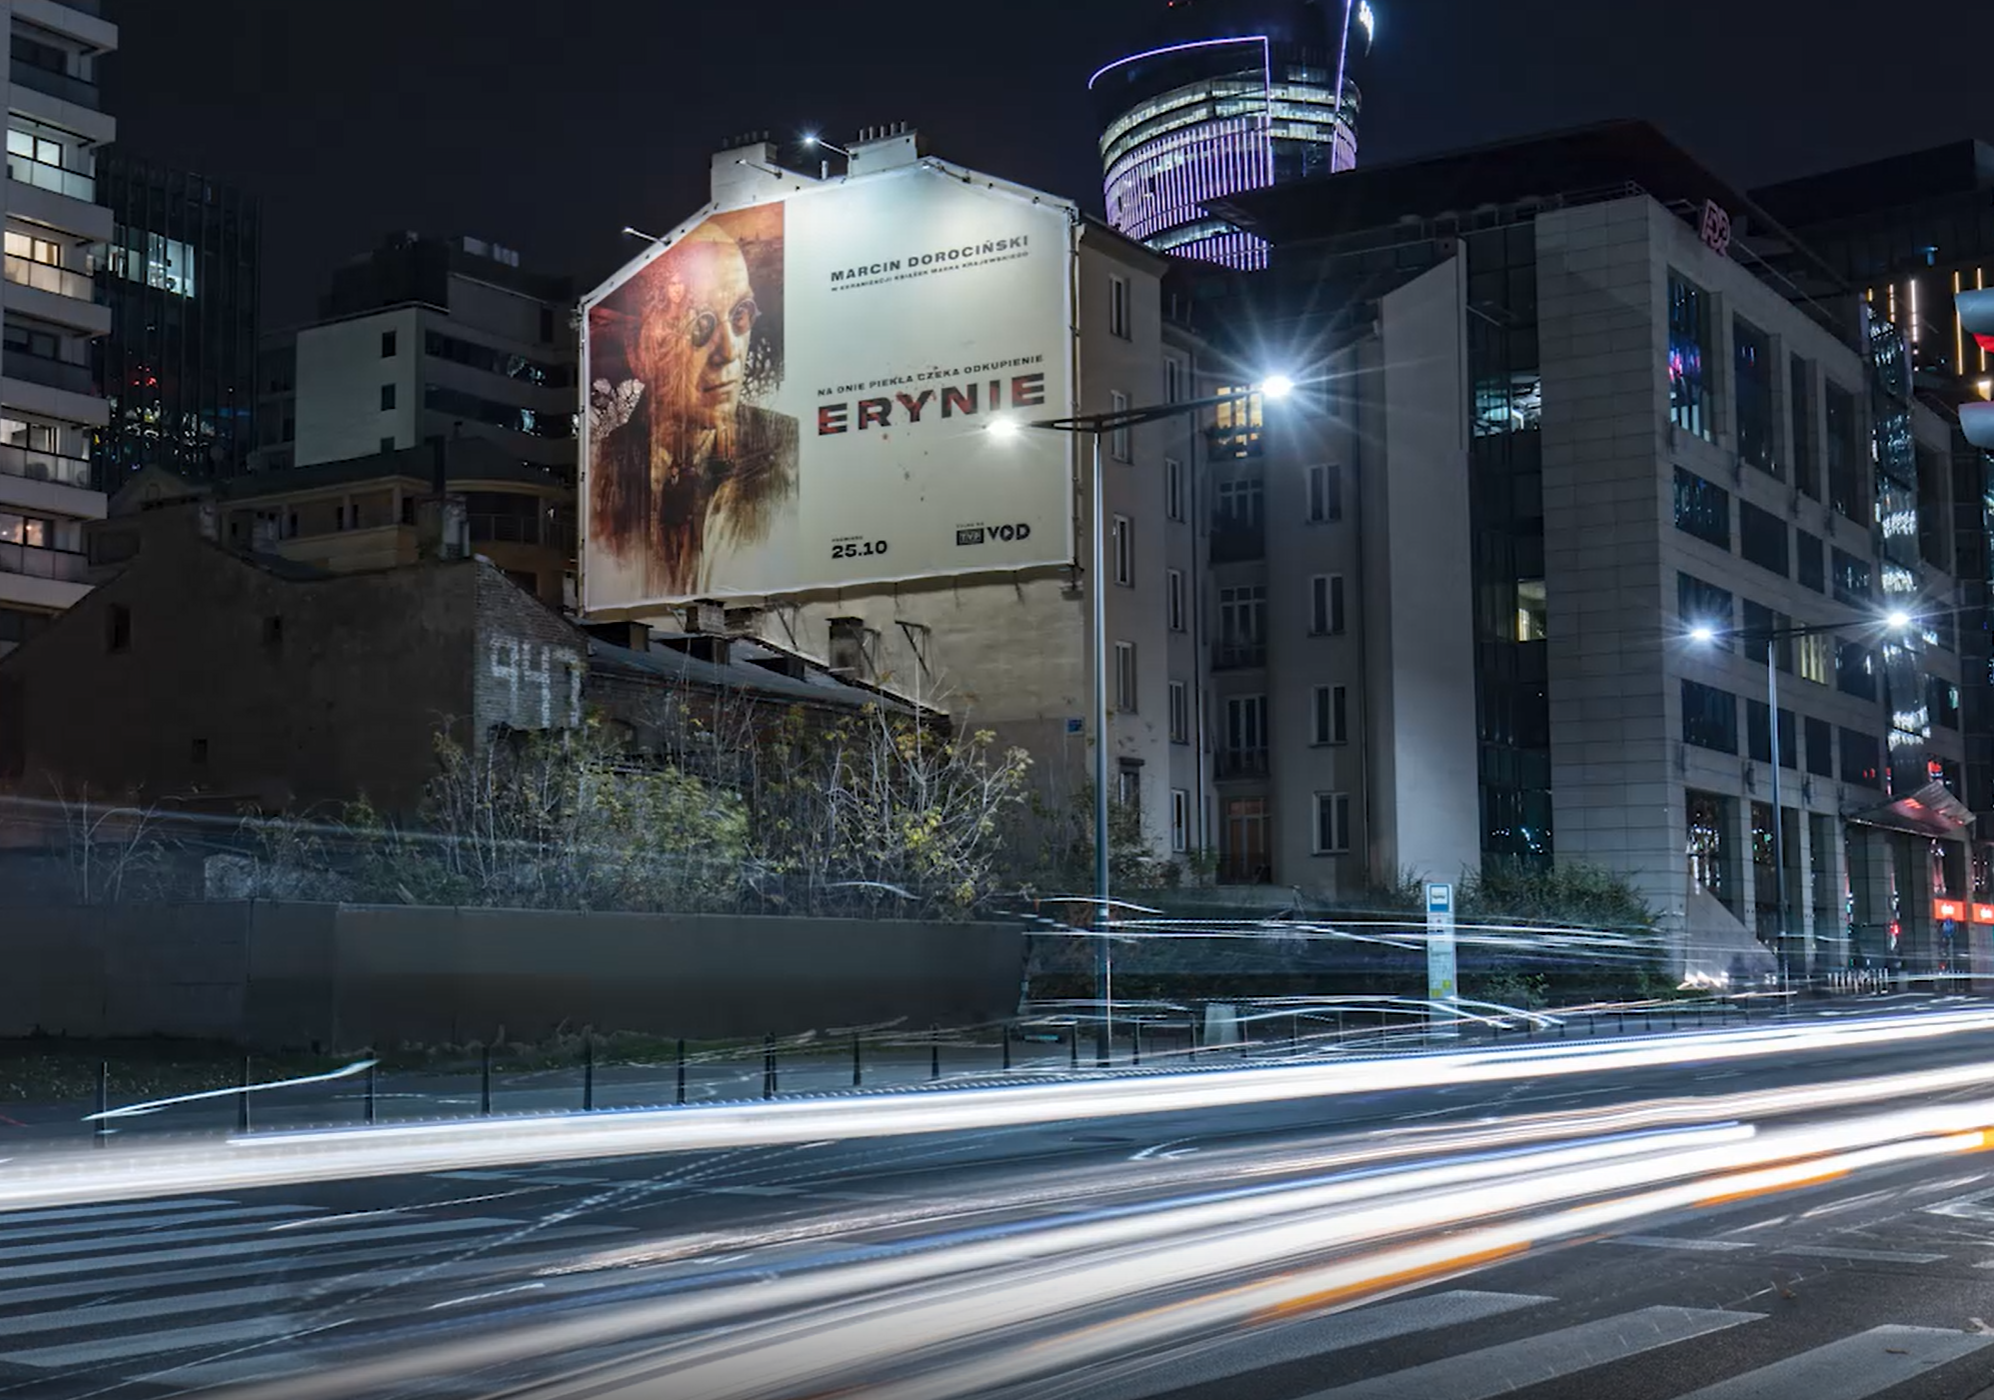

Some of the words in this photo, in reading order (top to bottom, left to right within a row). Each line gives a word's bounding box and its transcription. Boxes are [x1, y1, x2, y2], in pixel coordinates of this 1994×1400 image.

[831, 260, 901, 282] MARCIN
[908, 235, 1028, 267] DOROCIŃSKI
[817, 387, 833, 396] NA
[869, 375, 913, 389] PIEKŁA
[917, 368, 960, 382] CZEKA
[964, 355, 1043, 374] ODKUPIENIE
[818, 373, 1045, 436] ERYNIE
[832, 540, 888, 559] 25.10
[986, 523, 1031, 542] VOD
